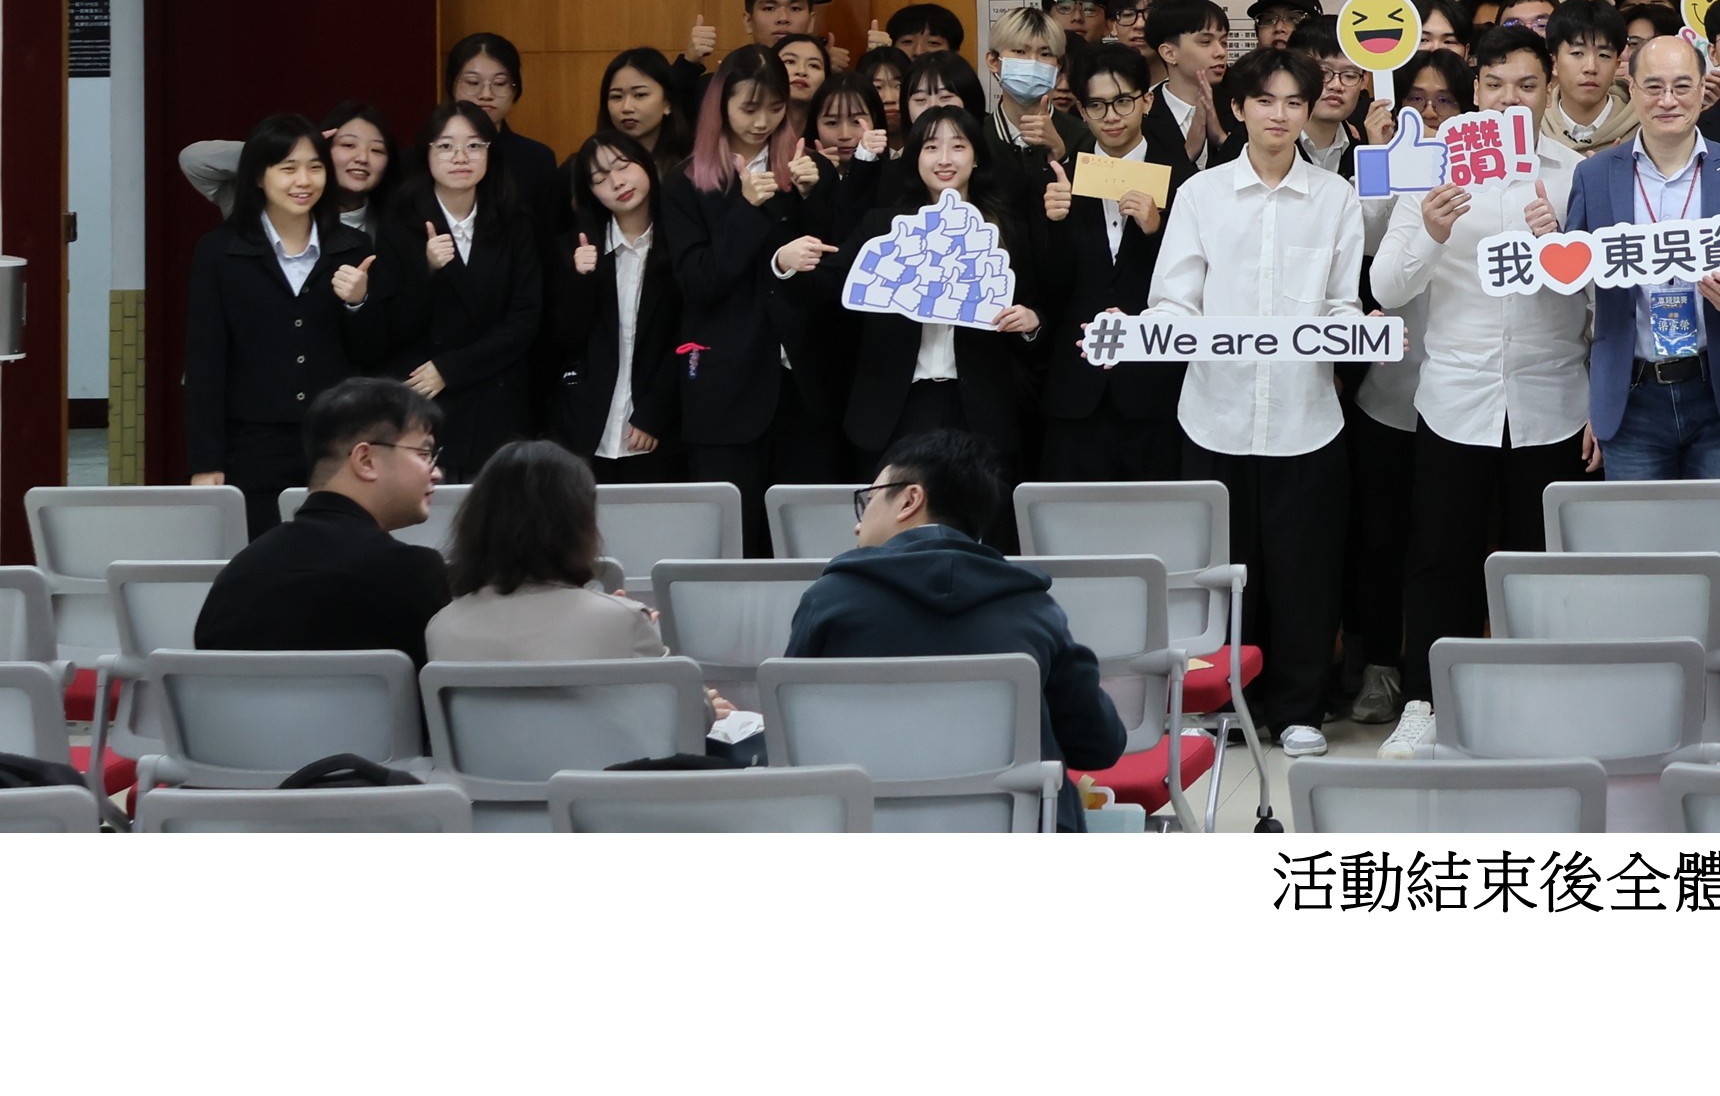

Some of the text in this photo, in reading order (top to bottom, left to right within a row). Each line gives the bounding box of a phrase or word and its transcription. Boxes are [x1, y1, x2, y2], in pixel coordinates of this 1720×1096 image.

[1445, 115, 1535, 186] 讚!
[1487, 241, 1535, 288] 我
[1140, 323, 1197, 355] We
[1211, 333, 1278, 355] are
[1292, 323, 1390, 355] CSIM
